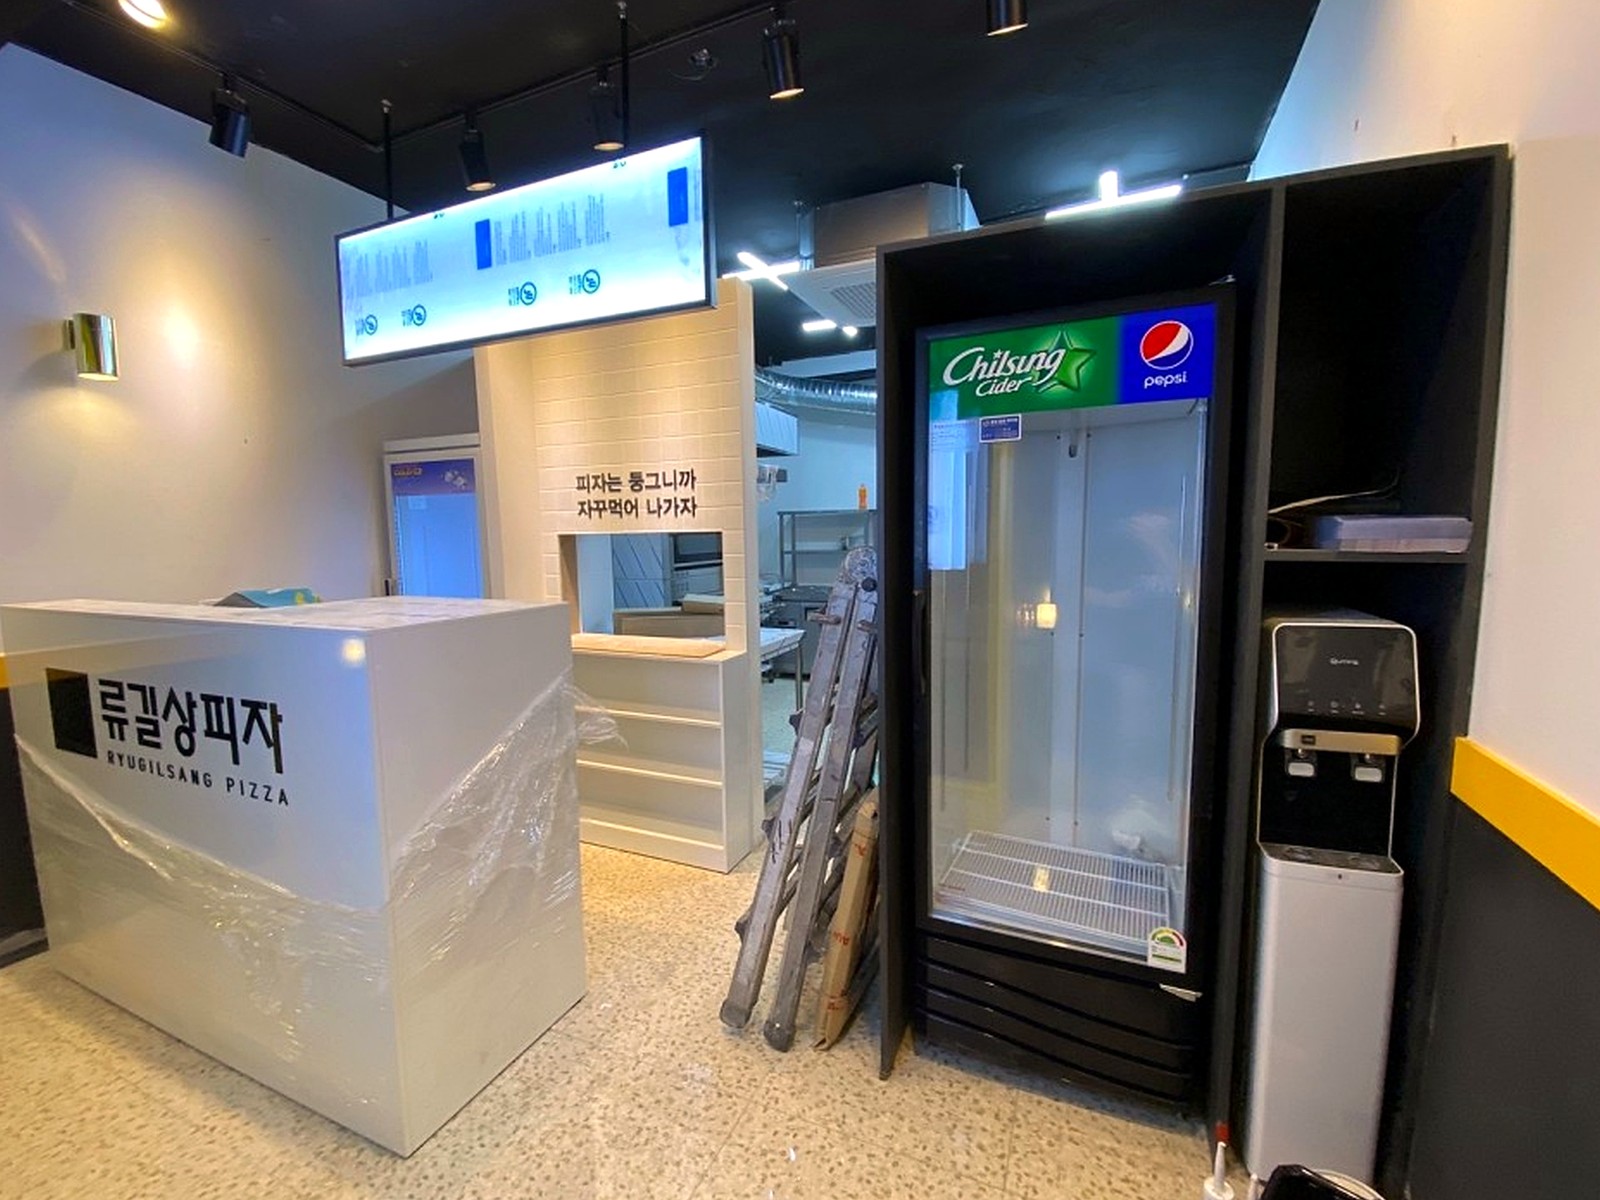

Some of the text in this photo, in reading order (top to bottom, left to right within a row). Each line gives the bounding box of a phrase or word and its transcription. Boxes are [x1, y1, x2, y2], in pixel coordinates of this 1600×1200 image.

[942, 346, 1066, 386] Chilsung
[975, 377, 1032, 397] Cider
[1143, 370, 1188, 390] pepsi
[576, 467, 697, 494] 피자는 둥그니까
[577, 495, 698, 519] 자꾸먹어 나가자
[98, 678, 284, 774] 류길상피자
[107, 751, 289, 806] RYUGILSANG PIZZA
